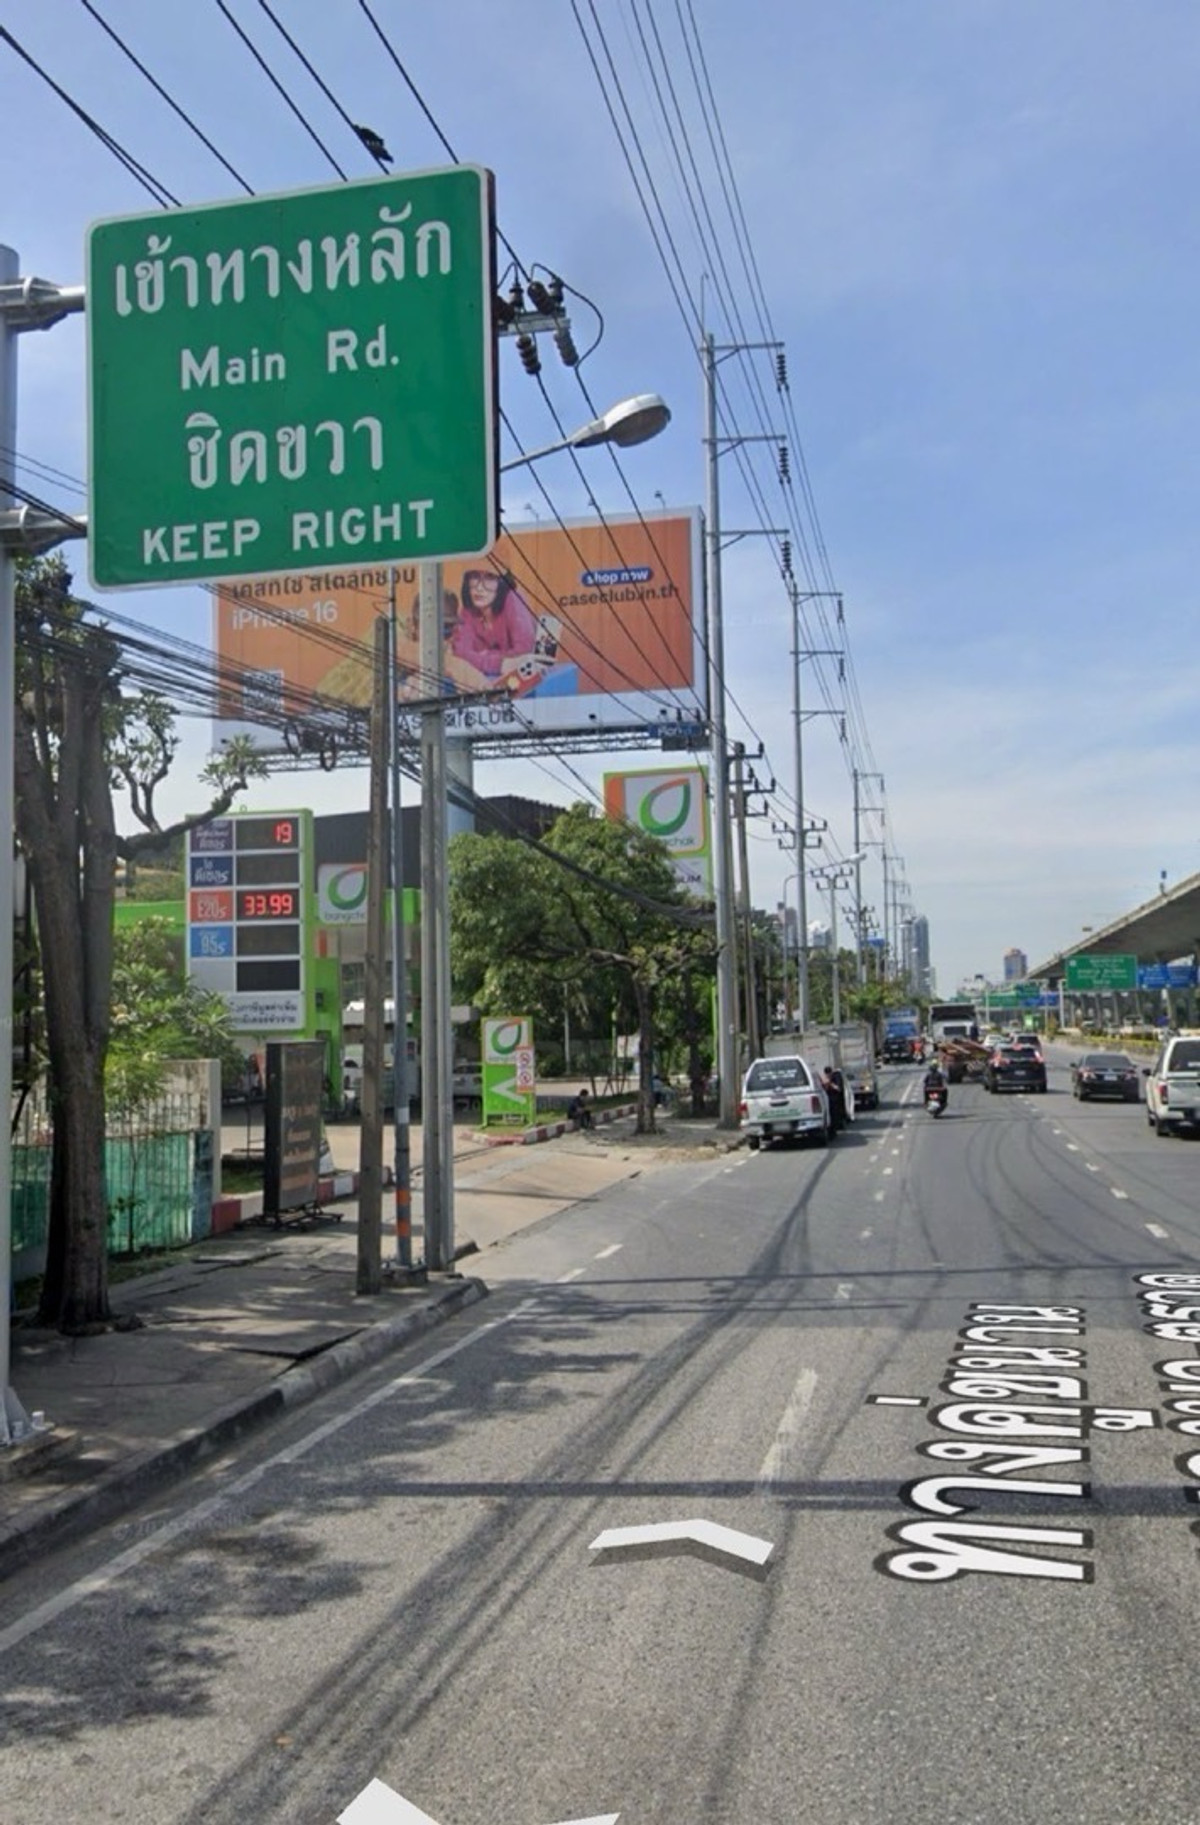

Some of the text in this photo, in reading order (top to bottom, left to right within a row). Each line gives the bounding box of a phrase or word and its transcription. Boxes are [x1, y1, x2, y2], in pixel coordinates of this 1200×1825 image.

[114, 201, 452, 318] เข้าทางหลัก
[181, 324, 400, 391] Main Rd.
[184, 411, 384, 490] ชิดขวา
[142, 499, 435, 565] KEEP RIGHT
[231, 599, 339, 631] iPhe 16
[275, 822, 293, 844] 19
[244, 893, 293, 917] 33.99
